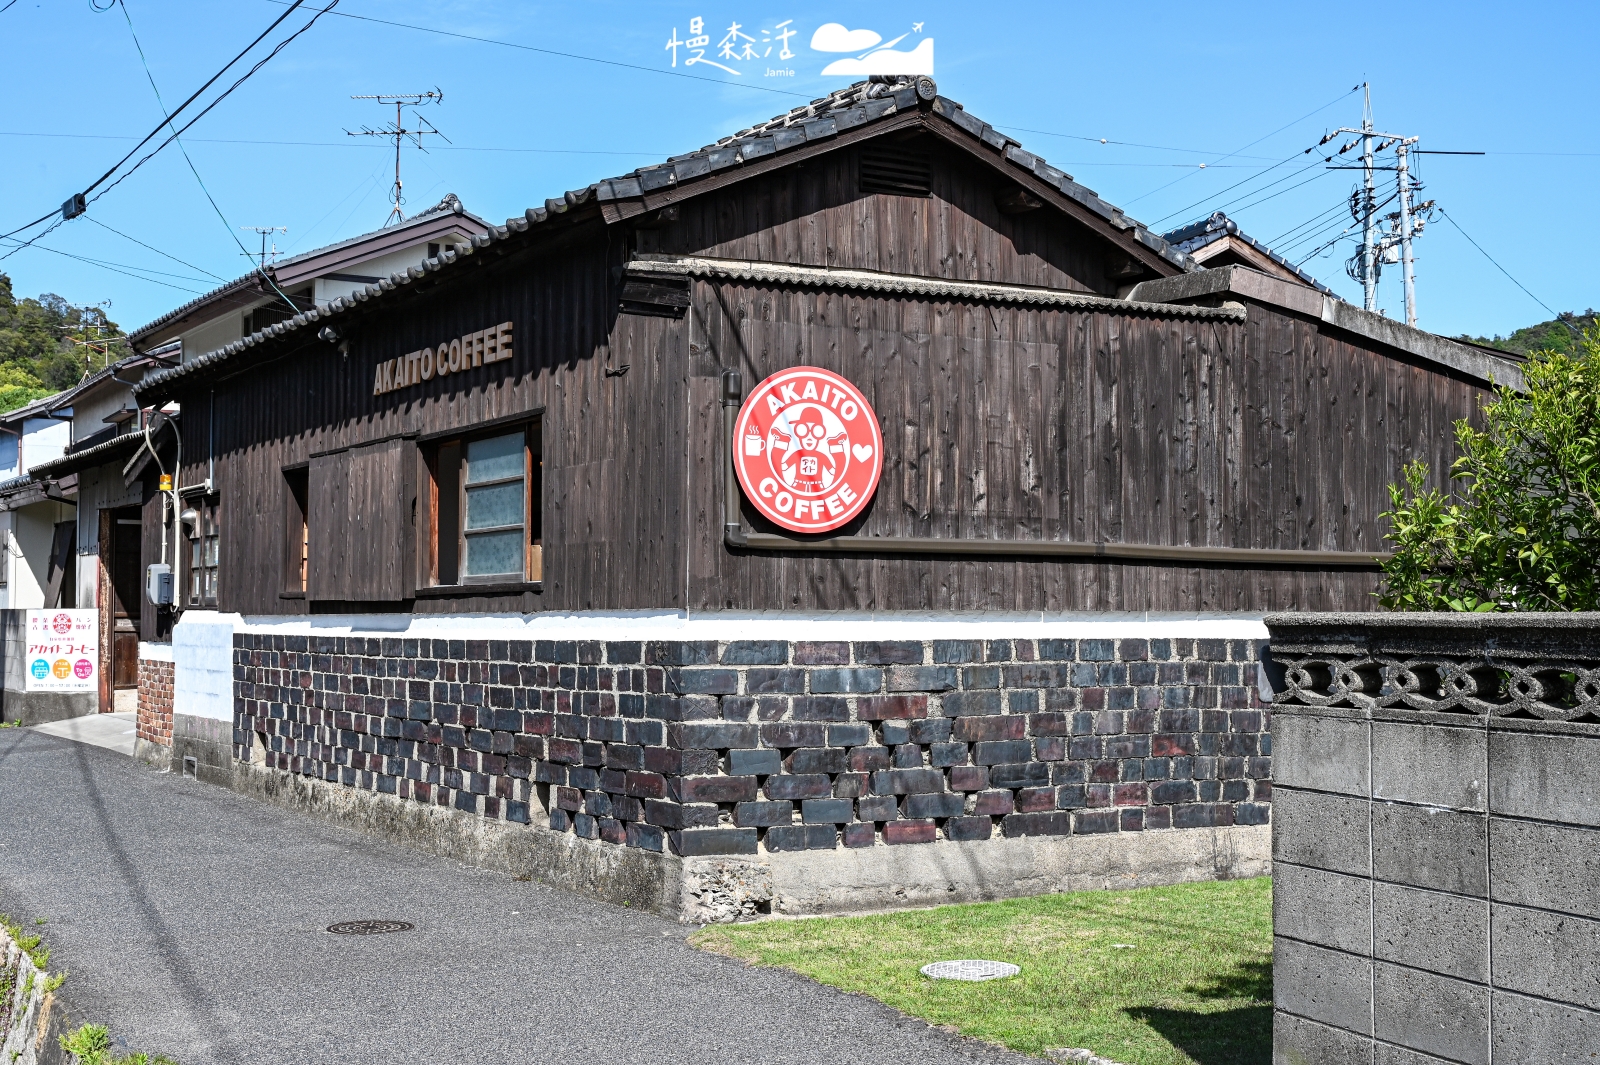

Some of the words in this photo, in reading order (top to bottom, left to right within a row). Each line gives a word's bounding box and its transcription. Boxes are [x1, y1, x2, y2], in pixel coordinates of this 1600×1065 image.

[373, 347, 436, 396] AKAITO
[436, 321, 513, 377] COFFEE
[766, 380, 858, 421] AKAITO
[759, 477, 858, 520] COFFEE
[29, 644, 62, 654] アカイト
[65, 644, 95, 654] コーヒー
